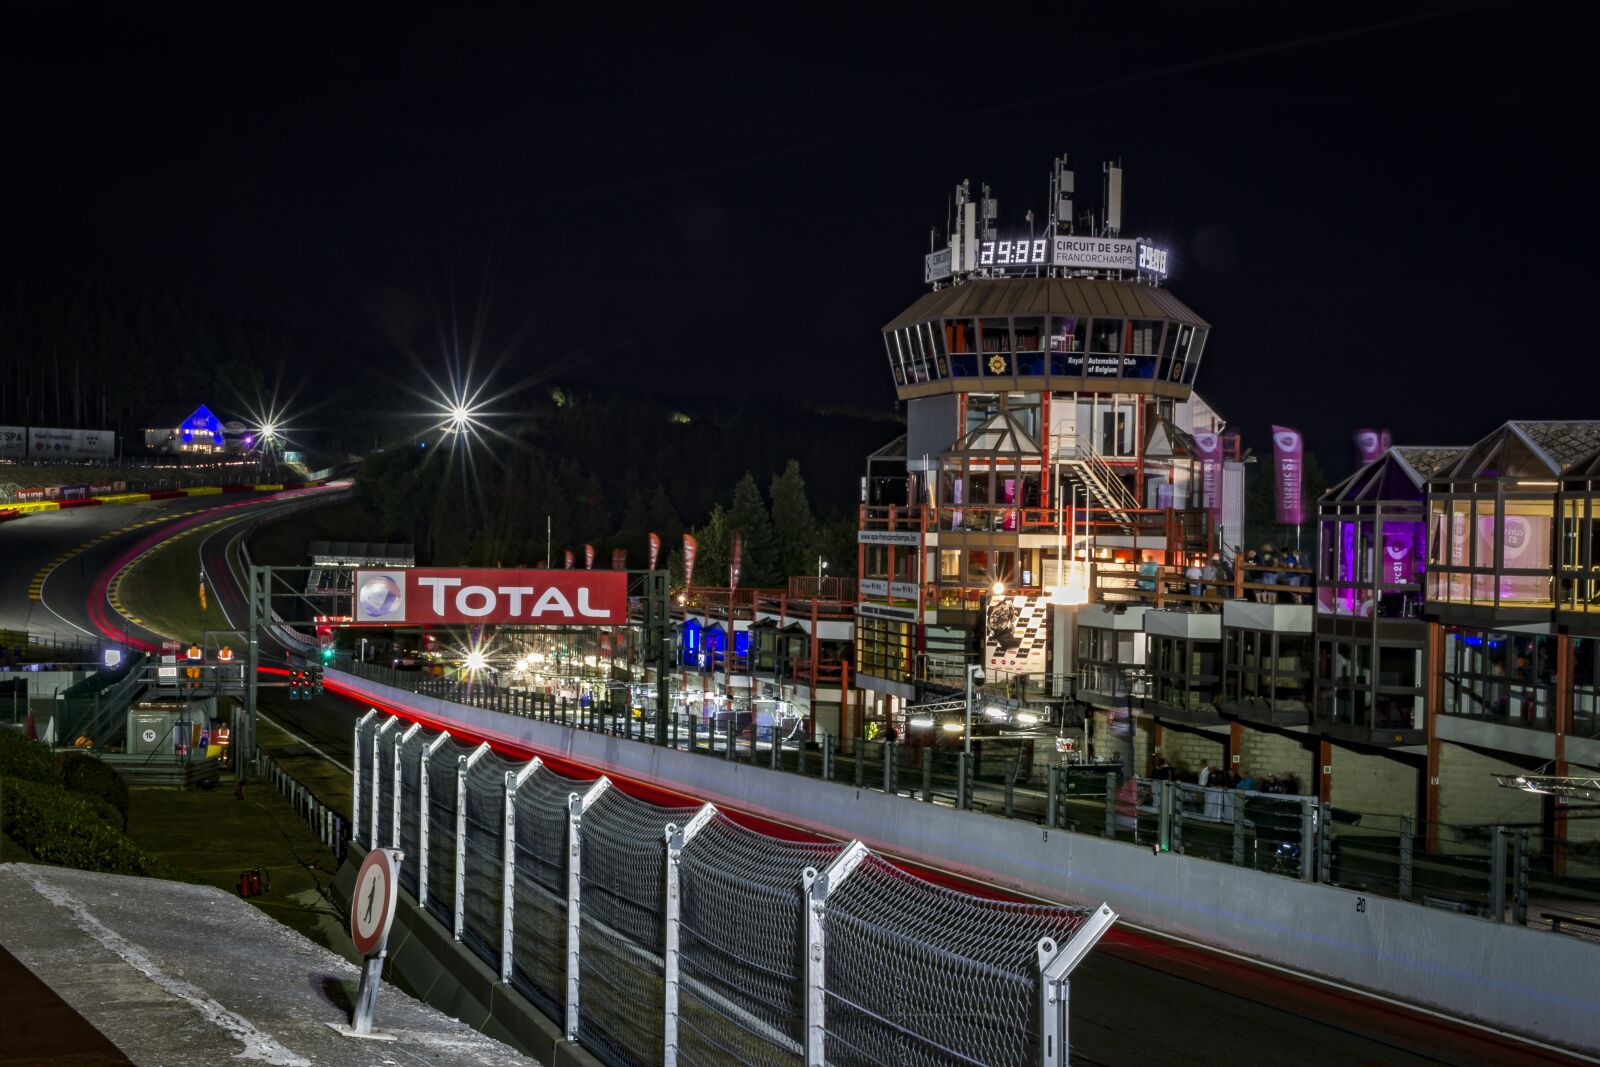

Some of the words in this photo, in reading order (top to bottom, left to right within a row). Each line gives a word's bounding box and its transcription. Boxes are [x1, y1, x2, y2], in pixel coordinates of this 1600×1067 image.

[1056, 241, 1095, 252] CIRCUIT
[1098, 243, 1111, 252] DE
[1113, 244, 1133, 254] SPA
[1056, 252, 1133, 265] FRANCORCHAMPS
[1067, 357, 1084, 366] Royal
[1088, 357, 1119, 365] Automobile
[1123, 358, 1137, 366] Club
[1095, 366, 1118, 375] Belgium
[5, 432, 23, 441] SPA
[418, 577, 611, 618] TOTAL
[1356, 897, 1366, 913] 20
